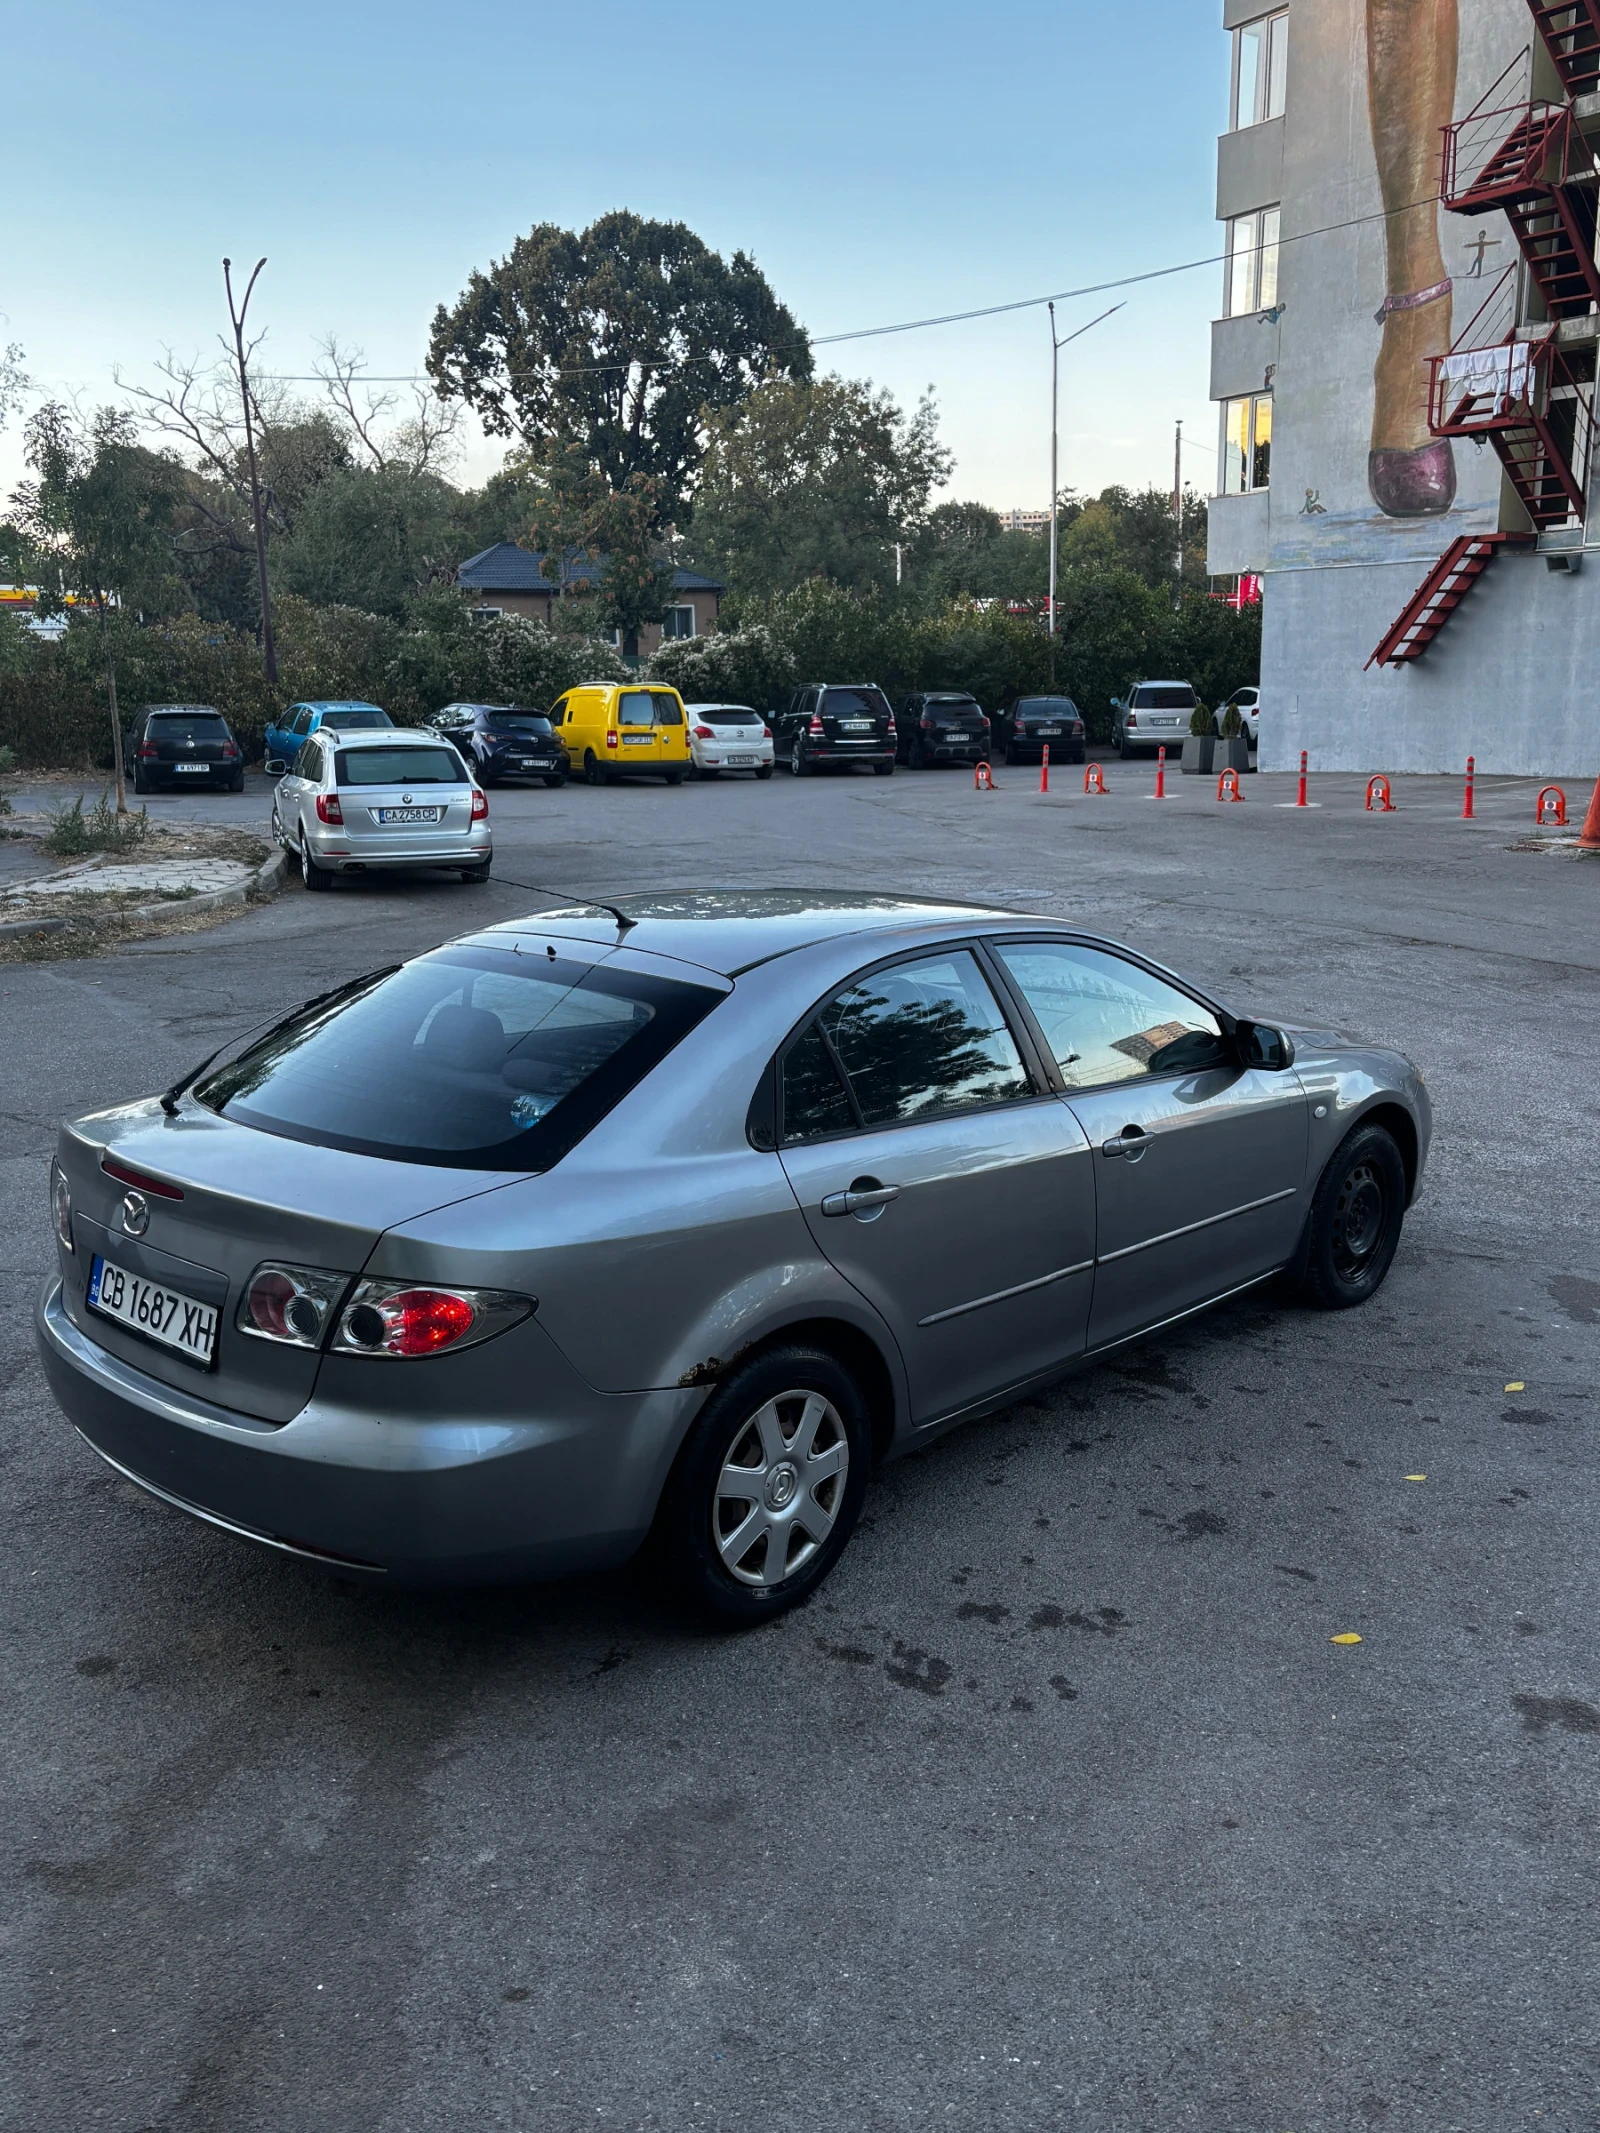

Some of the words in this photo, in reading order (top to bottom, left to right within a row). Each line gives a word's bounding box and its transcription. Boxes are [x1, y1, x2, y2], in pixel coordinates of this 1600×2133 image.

[385, 810, 398, 820] CA
[400, 809, 421, 819] 2758
[422, 809, 435, 819] CP
[102, 1266, 125, 1309] CB
[130, 1280, 179, 1334] 1687
[179, 1302, 213, 1353] XH
